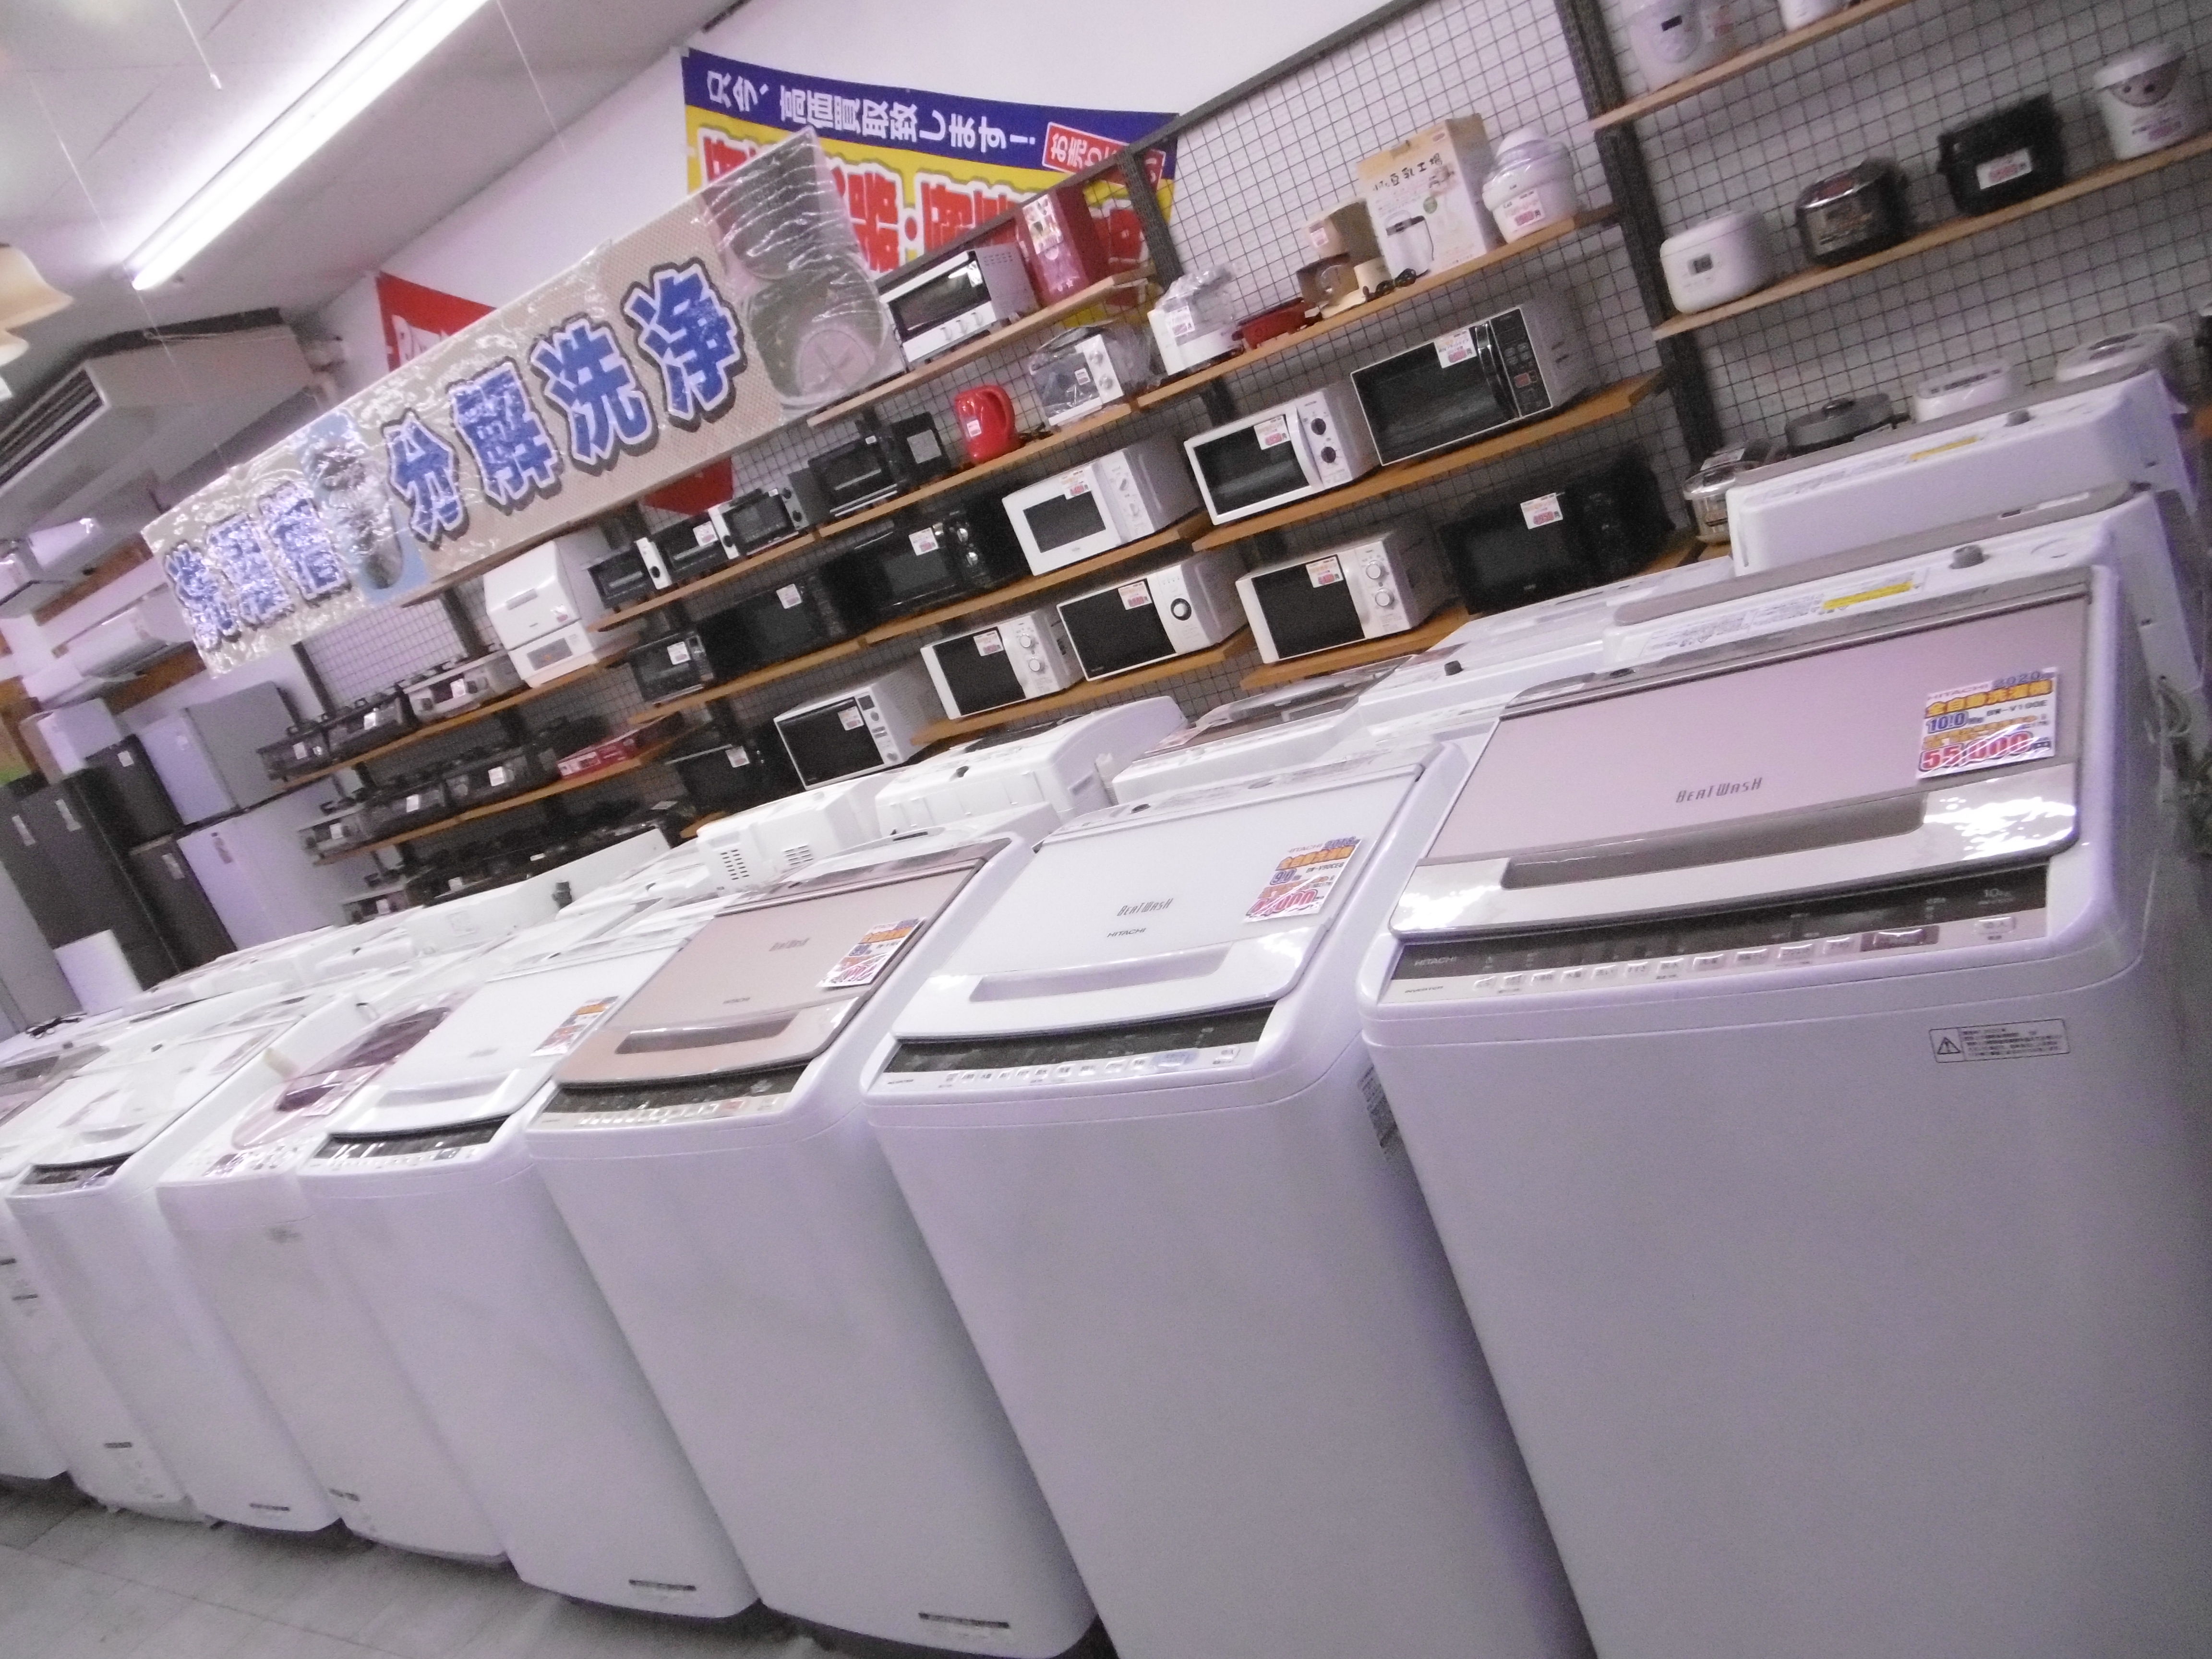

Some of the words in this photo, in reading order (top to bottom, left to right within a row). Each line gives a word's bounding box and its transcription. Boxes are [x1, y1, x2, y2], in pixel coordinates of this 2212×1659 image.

[383, 258, 748, 545] 分解洗浄
[1107, 928, 1146, 938] HITACHI
